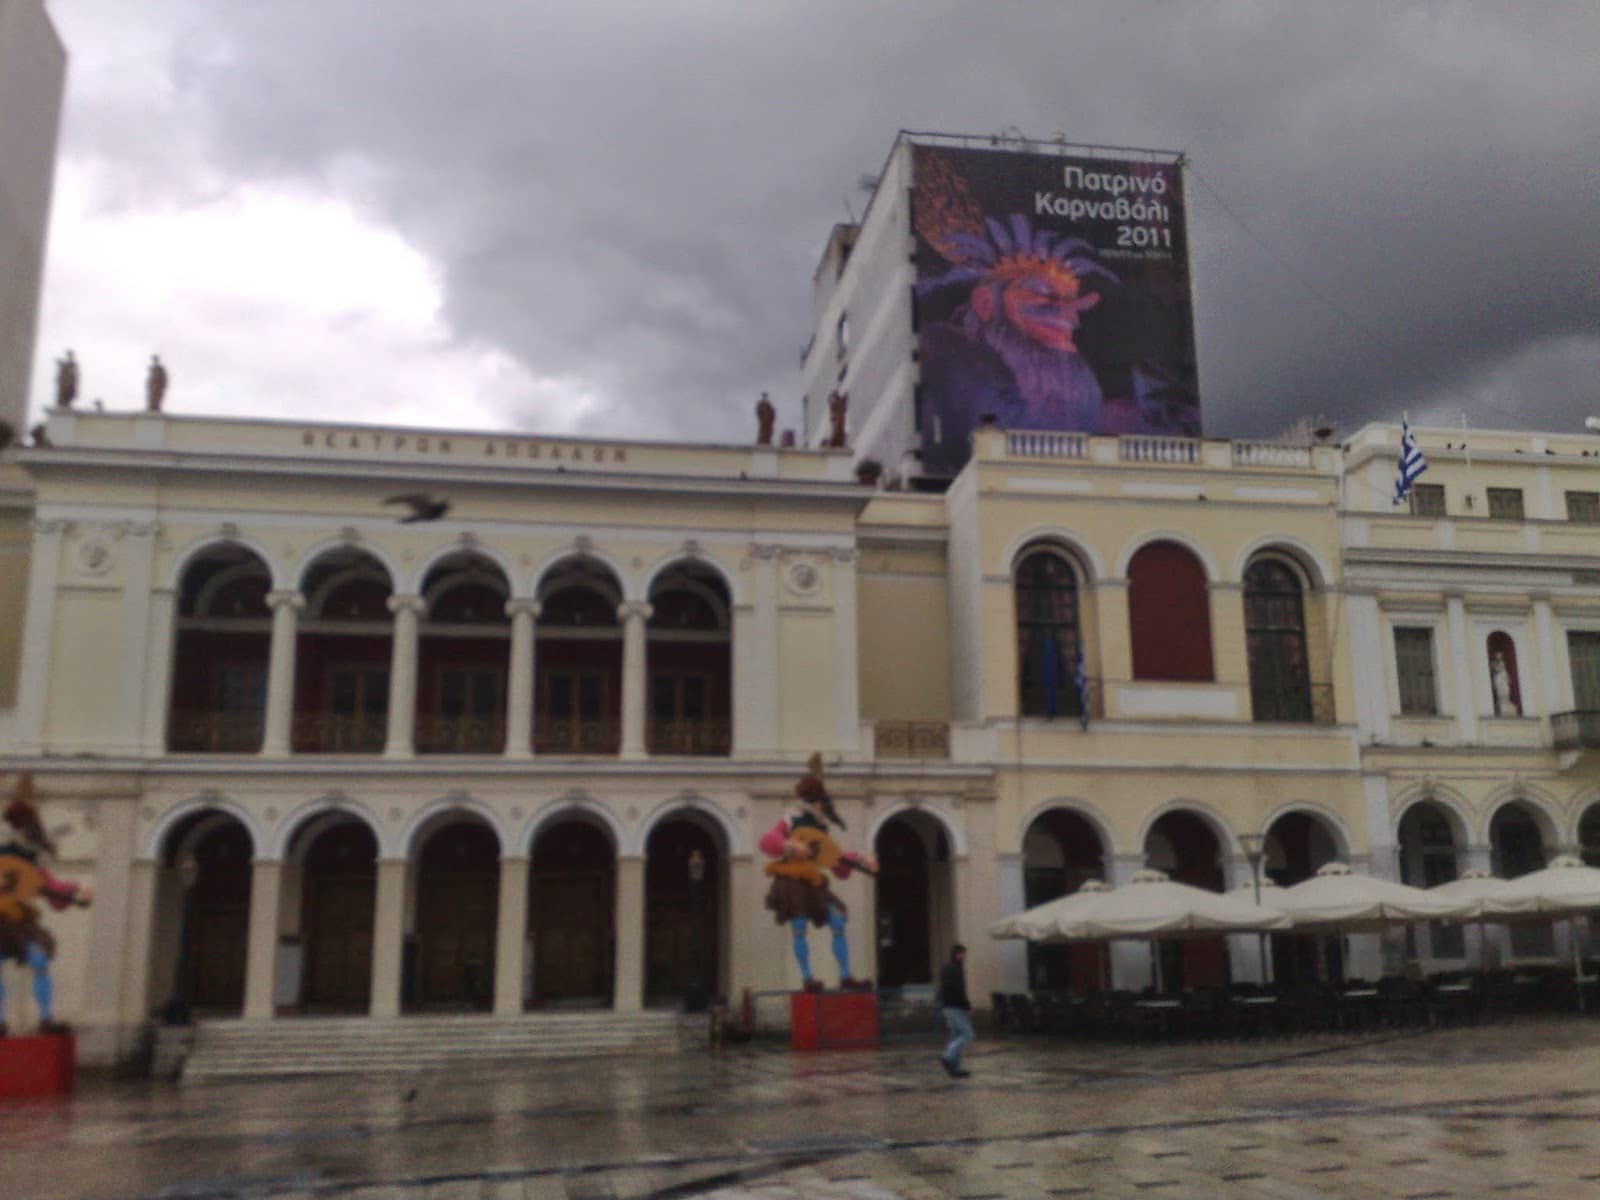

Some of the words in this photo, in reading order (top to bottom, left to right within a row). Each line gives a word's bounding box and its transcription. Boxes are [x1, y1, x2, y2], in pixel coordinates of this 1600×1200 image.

[1064, 166, 1166, 195] Πατρινό
[1035, 191, 1169, 222] Καρναβάλι
[1116, 225, 1171, 247] 2011
